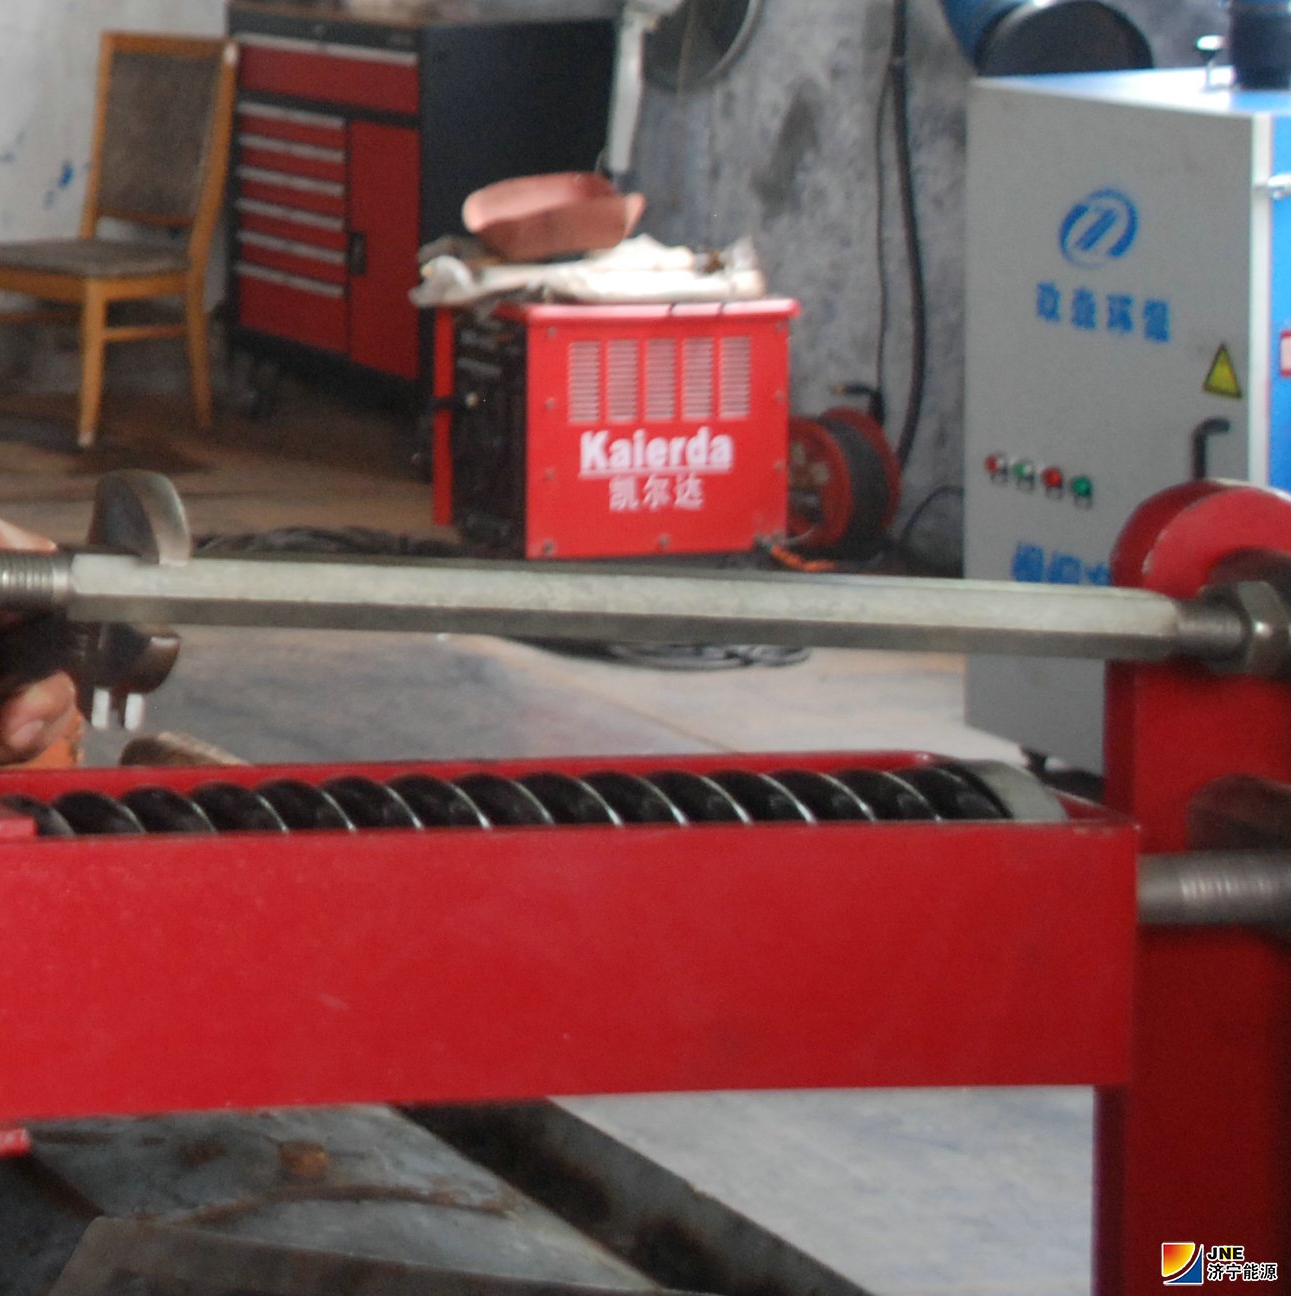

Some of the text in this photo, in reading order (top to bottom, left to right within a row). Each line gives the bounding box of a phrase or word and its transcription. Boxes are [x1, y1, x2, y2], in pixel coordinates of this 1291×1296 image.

[580, 426, 734, 473] Kaierda
[609, 473, 704, 511] 凯尔达
